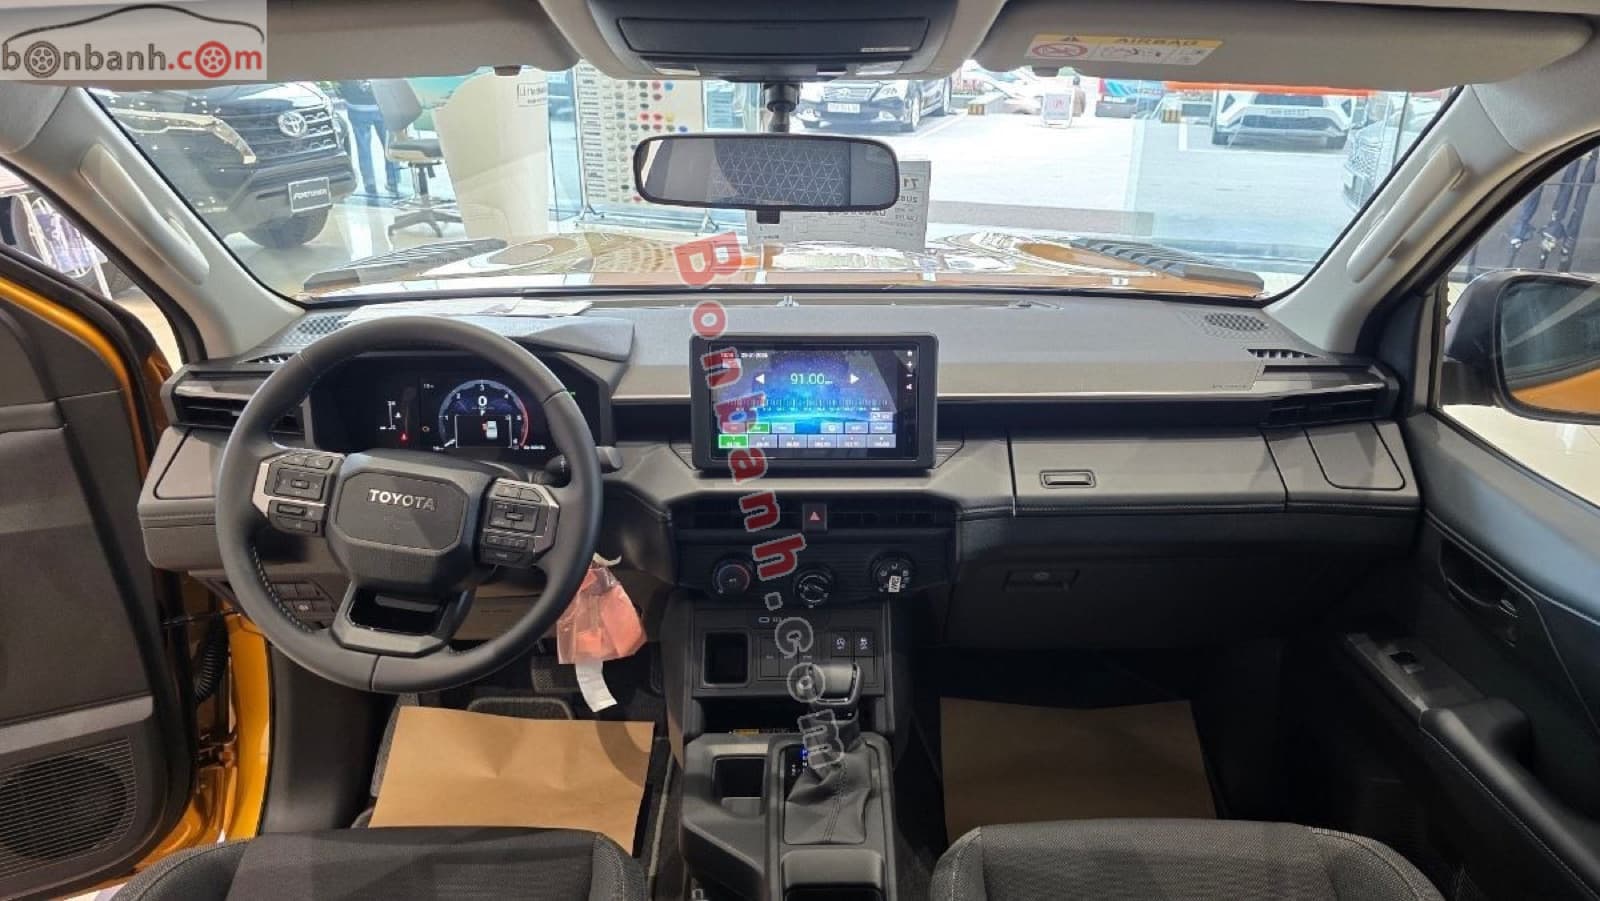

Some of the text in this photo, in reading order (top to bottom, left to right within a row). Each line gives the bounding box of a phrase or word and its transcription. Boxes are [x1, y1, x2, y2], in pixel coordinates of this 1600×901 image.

[1114, 37, 1199, 46] AIRBAG
[790, 372, 825, 385] 91.00
[368, 488, 437, 512] TOYOTA
